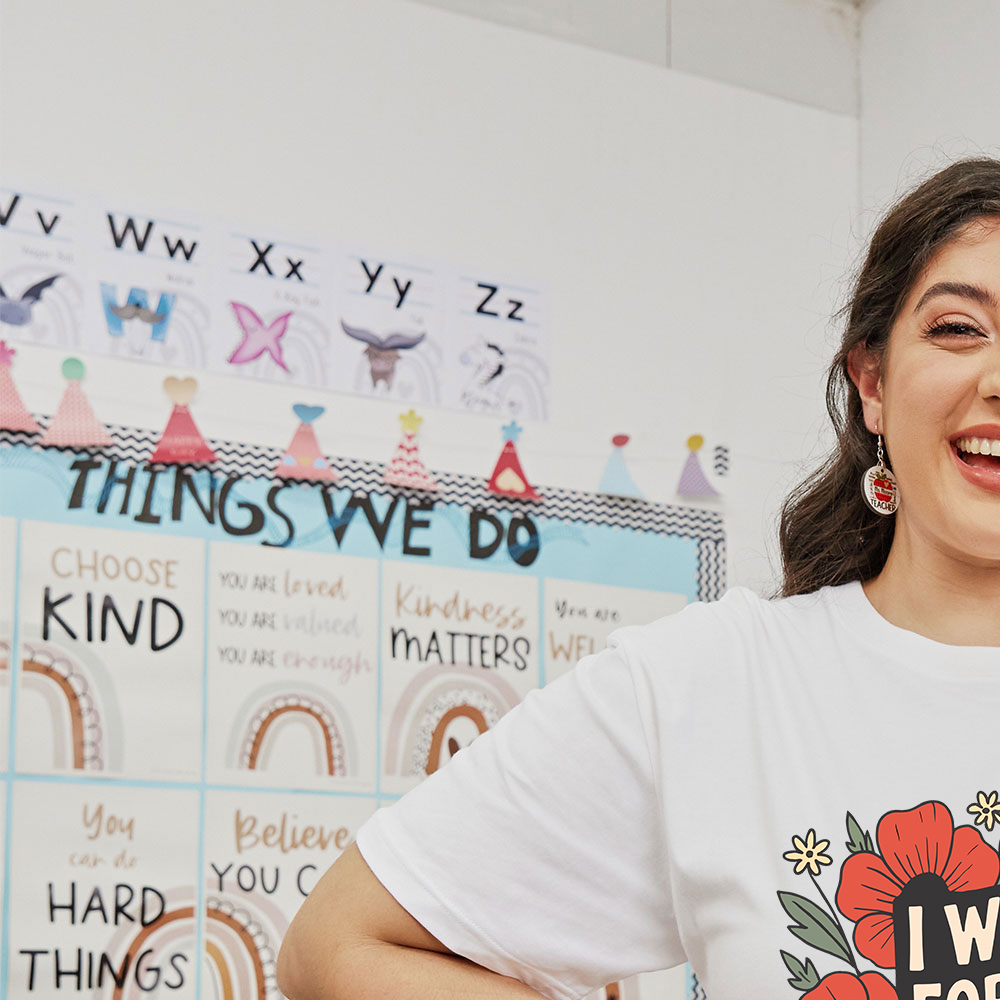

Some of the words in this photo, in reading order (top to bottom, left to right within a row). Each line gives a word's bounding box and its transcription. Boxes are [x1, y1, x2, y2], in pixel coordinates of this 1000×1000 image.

[68, 459, 294, 548] THINGS
[321, 485, 434, 556] WE
[469, 508, 541, 567] DO
[51, 548, 179, 589] CHOOSE
[219, 572, 248, 590] YOU
[251, 574, 277, 593] ARE
[283, 568, 347, 601] loved
[43, 586, 184, 652] KIND
[218, 608, 247, 628] YOU
[251, 611, 276, 631] ARE
[395, 582, 527, 630] Kindness
[555, 598, 587, 618] You
[217, 646, 247, 664] YOU
[251, 649, 275, 668] ARE
[282, 650, 372, 685] enough
[391, 626, 531, 671] MATTERS
[82, 803, 134, 841] You
[234, 809, 350, 853] Believe
[210, 863, 279, 893] YOU
[48, 881, 166, 927] HARD
[908, 902, 925, 971] I
[19, 948, 188, 991] THINGS
